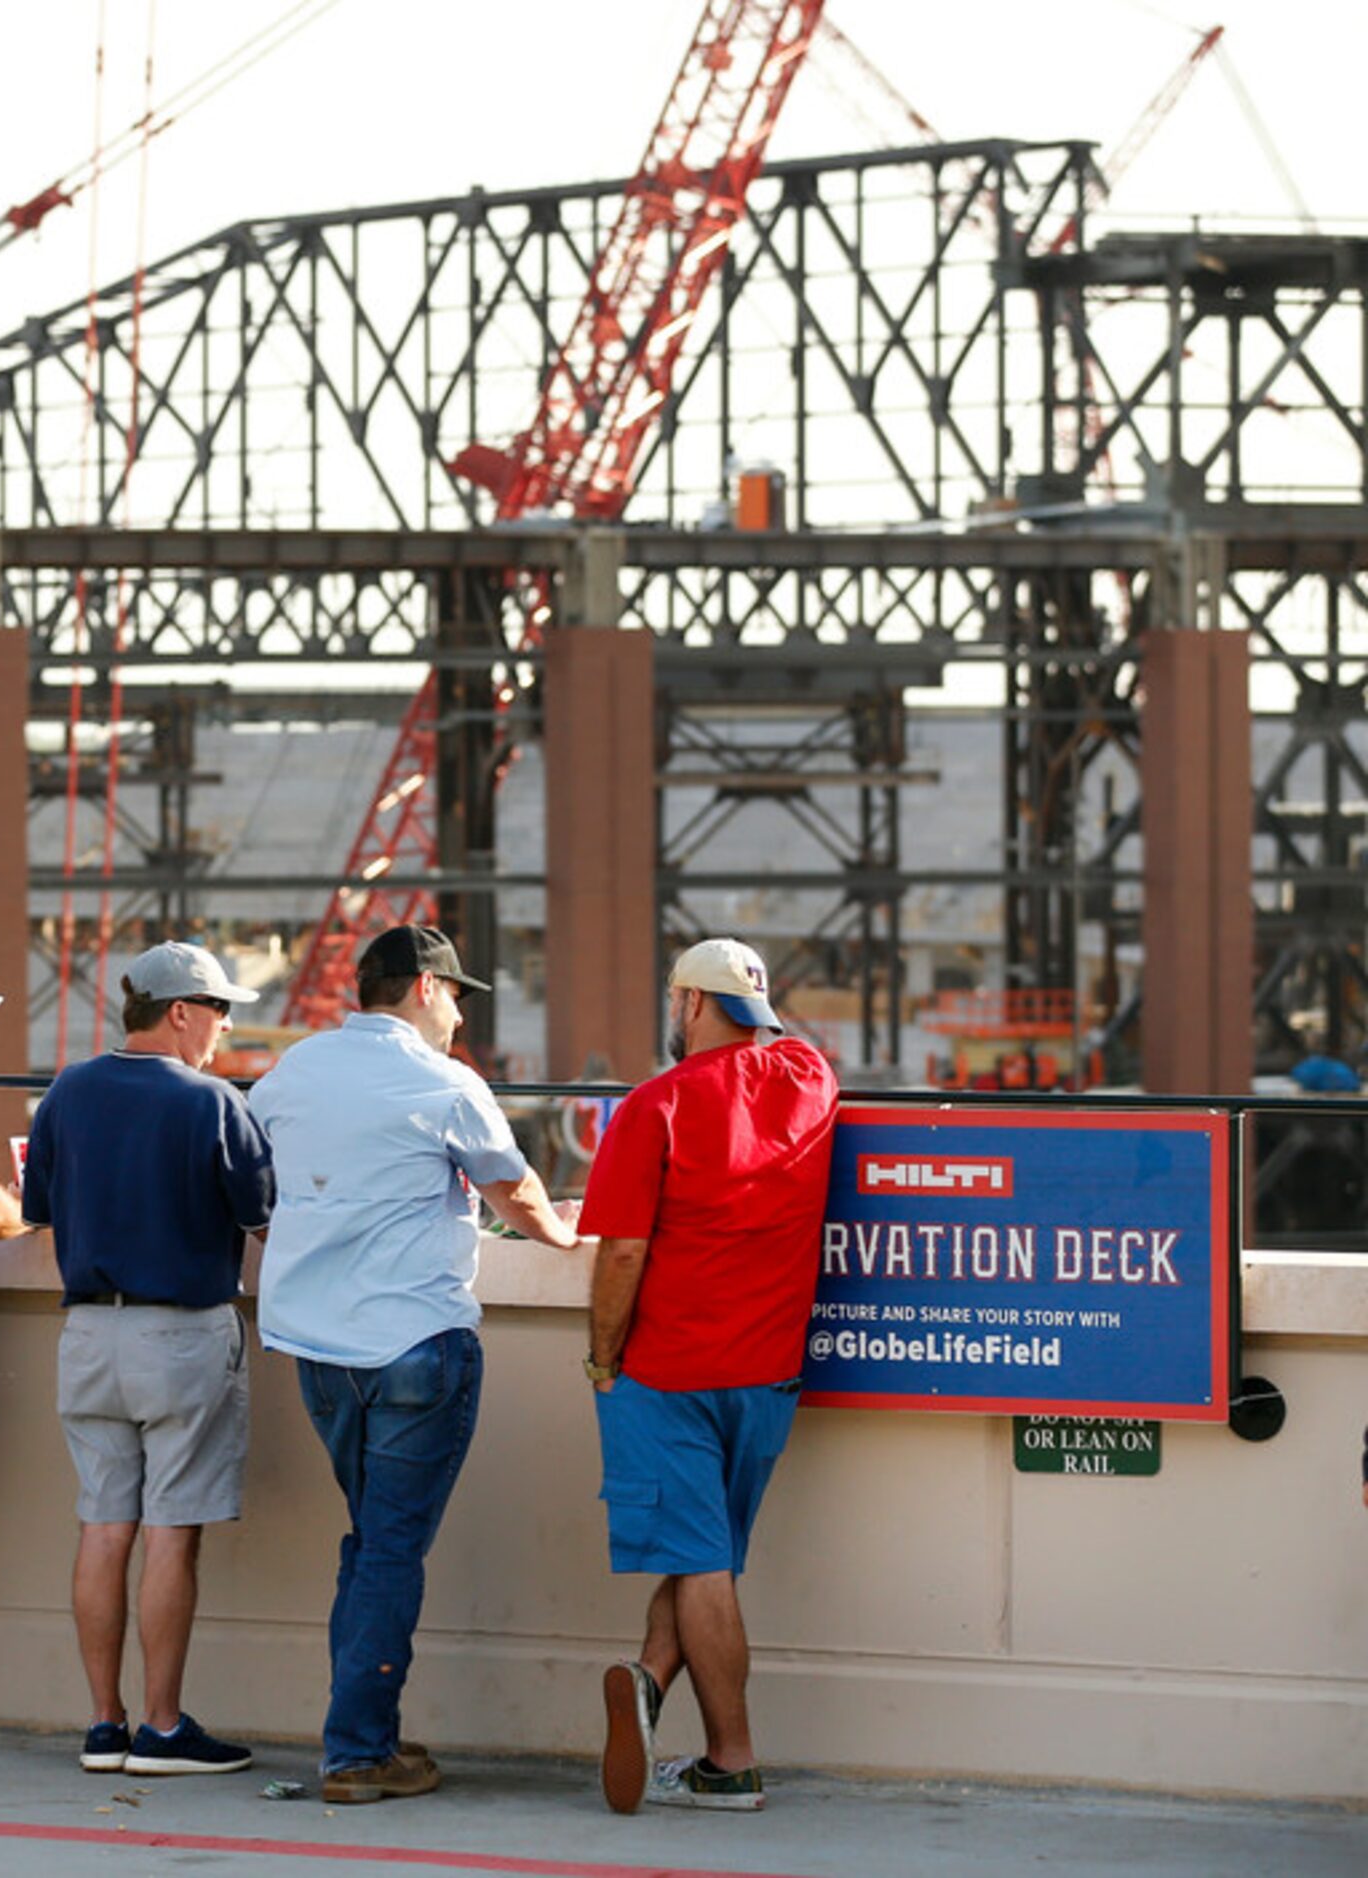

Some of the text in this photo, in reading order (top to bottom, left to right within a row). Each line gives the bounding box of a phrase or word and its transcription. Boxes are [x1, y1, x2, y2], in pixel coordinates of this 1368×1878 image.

[747, 966, 765, 992] T
[866, 1162, 1004, 1188] HILTI
[823, 1222, 1181, 1284] RVATION DECK
[812, 1303, 1121, 1328] PICTURE AND SHARE YOUR STORY WITH
[809, 1330, 1061, 1366] @GlobeLifeField
[1023, 1429, 1153, 1451] OR LEAN ON
[1063, 1453, 1115, 1474] RAIL
